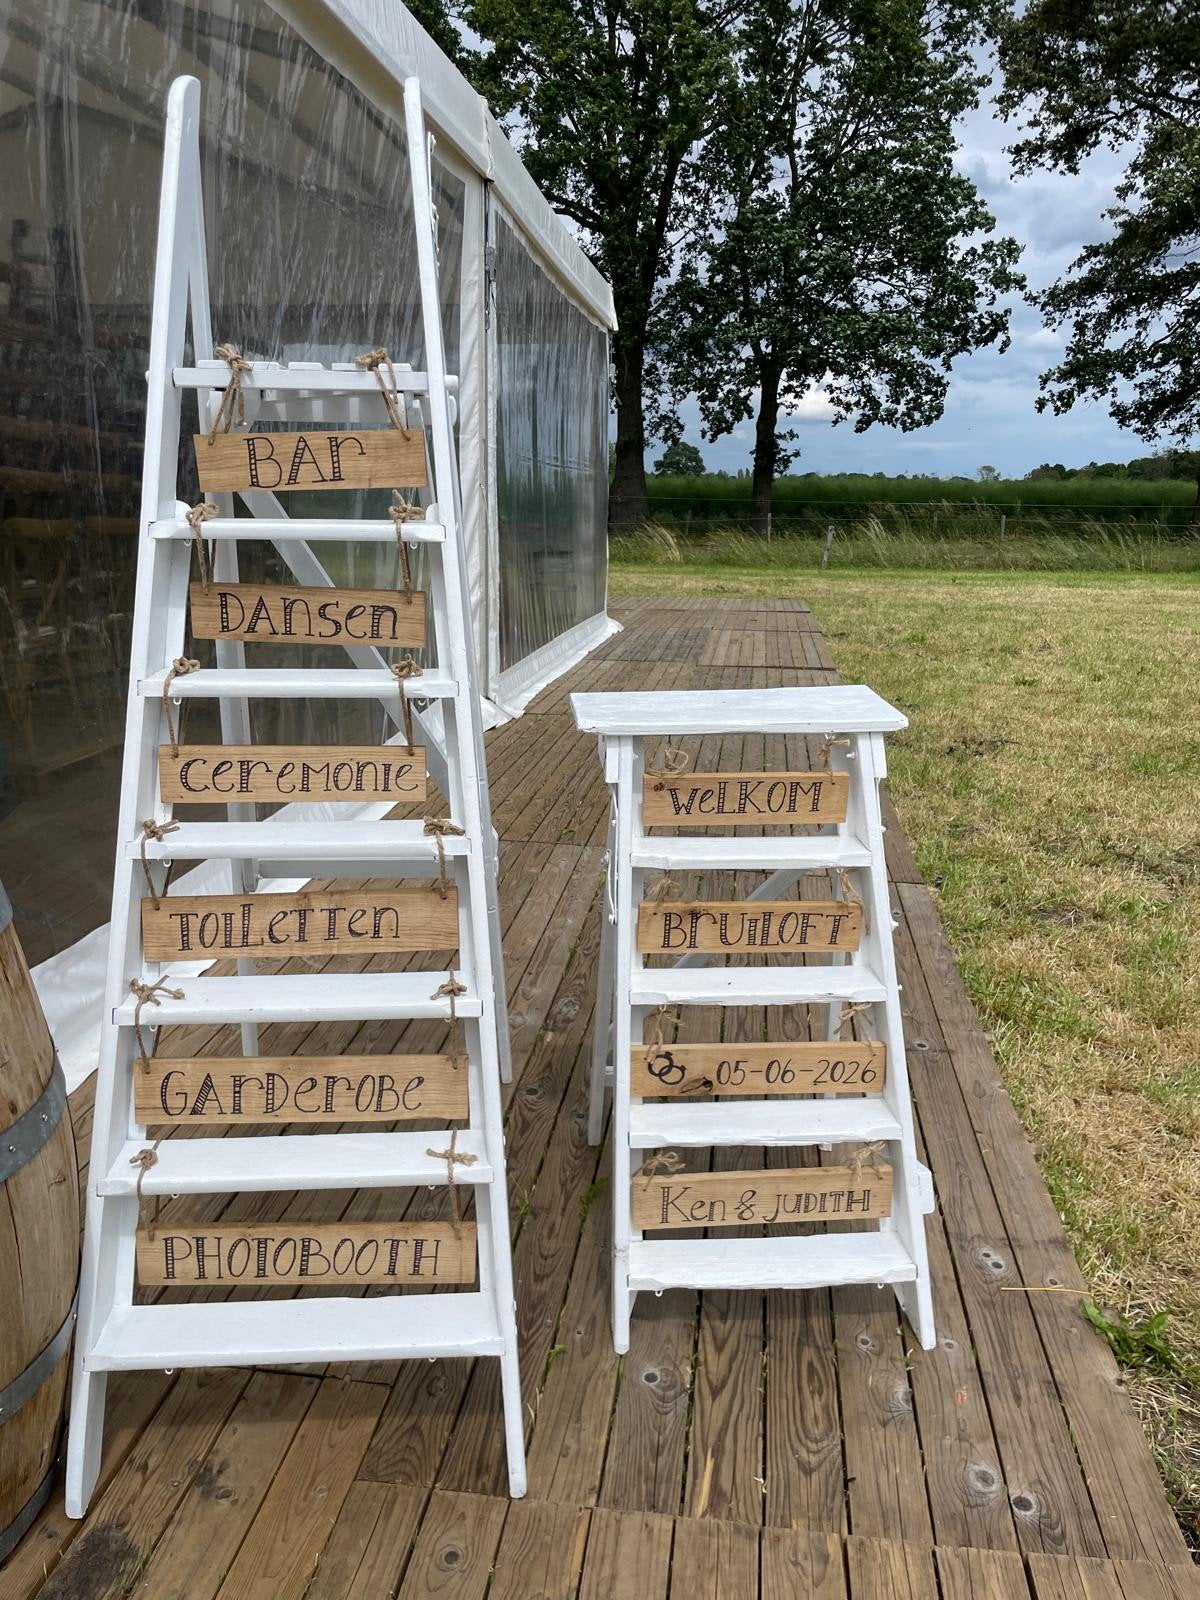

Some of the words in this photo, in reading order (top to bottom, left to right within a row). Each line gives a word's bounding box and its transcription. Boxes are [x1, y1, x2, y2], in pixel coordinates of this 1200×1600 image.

[716, 1058, 877, 1086] 05-06-2026
[660, 1186, 726, 1223] Ken
[734, 1189, 757, 1221] &
[161, 1236, 442, 1280] PHOTOBOOTH
